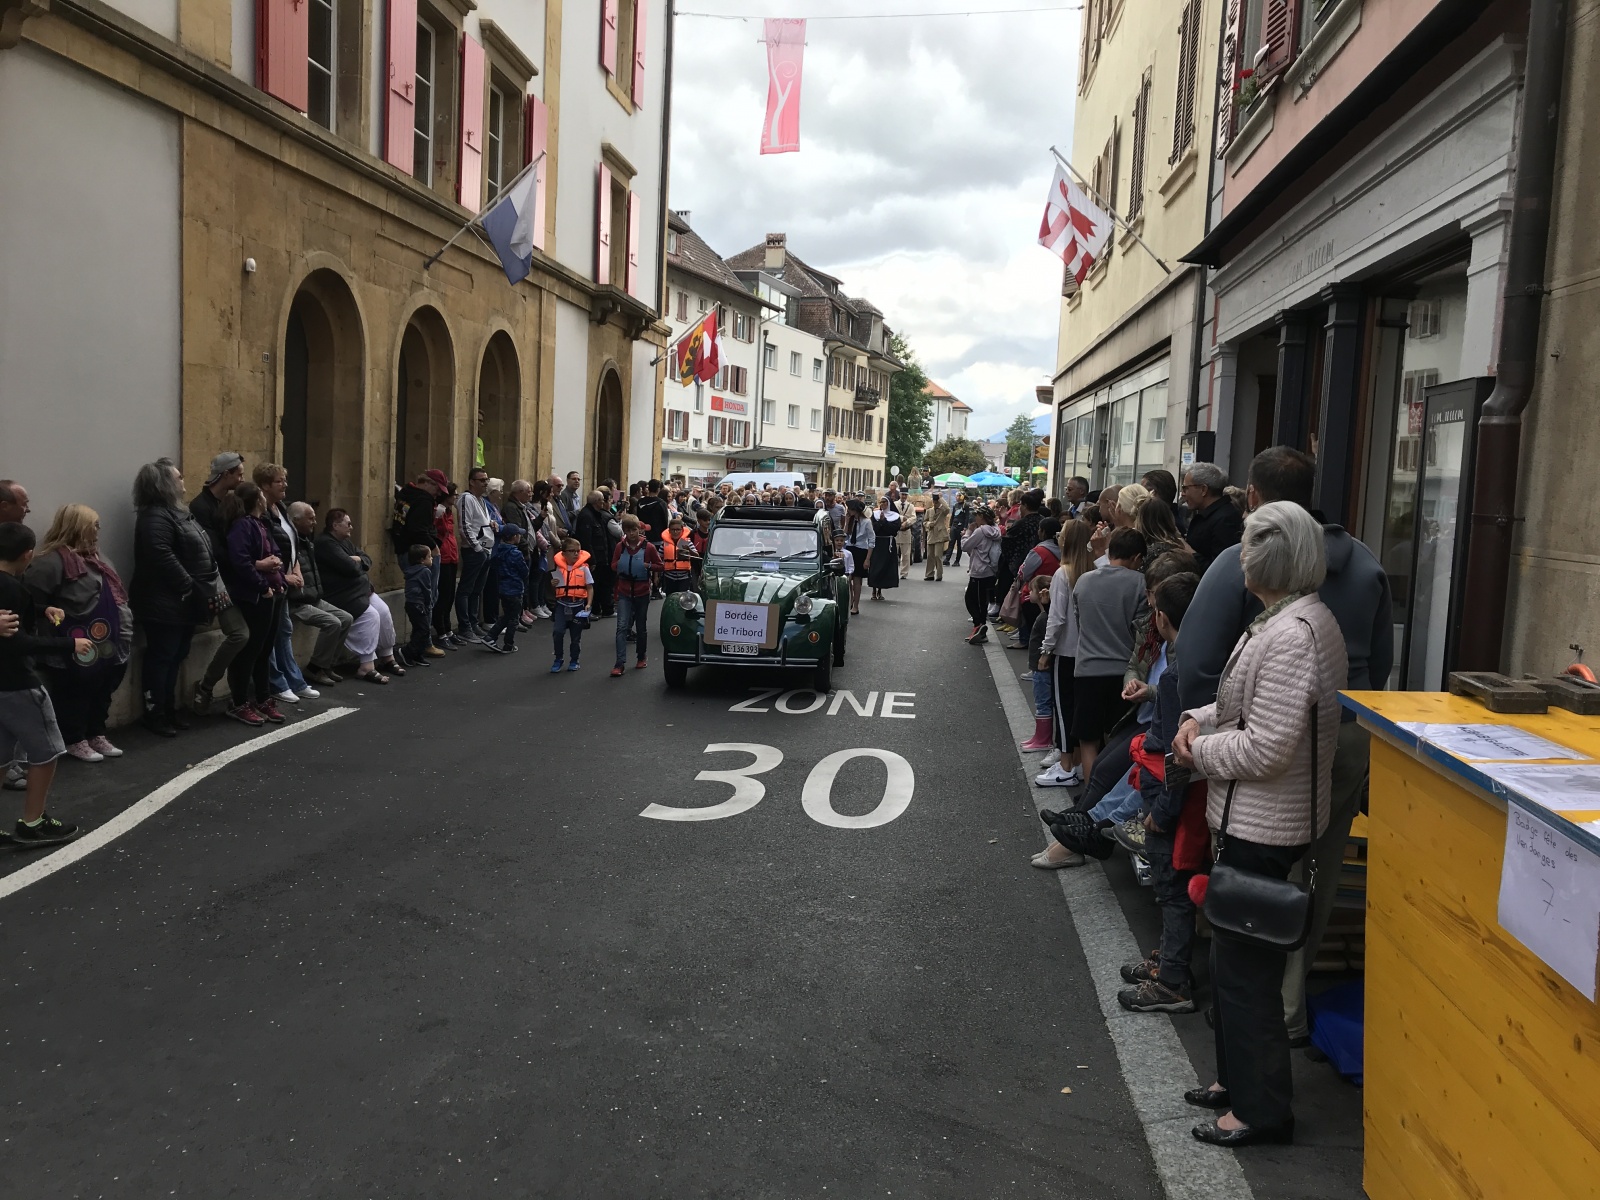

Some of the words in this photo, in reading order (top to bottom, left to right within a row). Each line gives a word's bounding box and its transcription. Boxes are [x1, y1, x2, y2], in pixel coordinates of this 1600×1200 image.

[724, 400, 745, 412] HONDA
[724, 610, 758, 621] Bordée
[717, 626, 728, 635] de
[731, 627, 763, 638] Tribord
[728, 687, 916, 719] ZONE
[639, 742, 915, 829] 30
[1513, 811, 1539, 840] Badge
[1564, 847, 1578, 862] des
